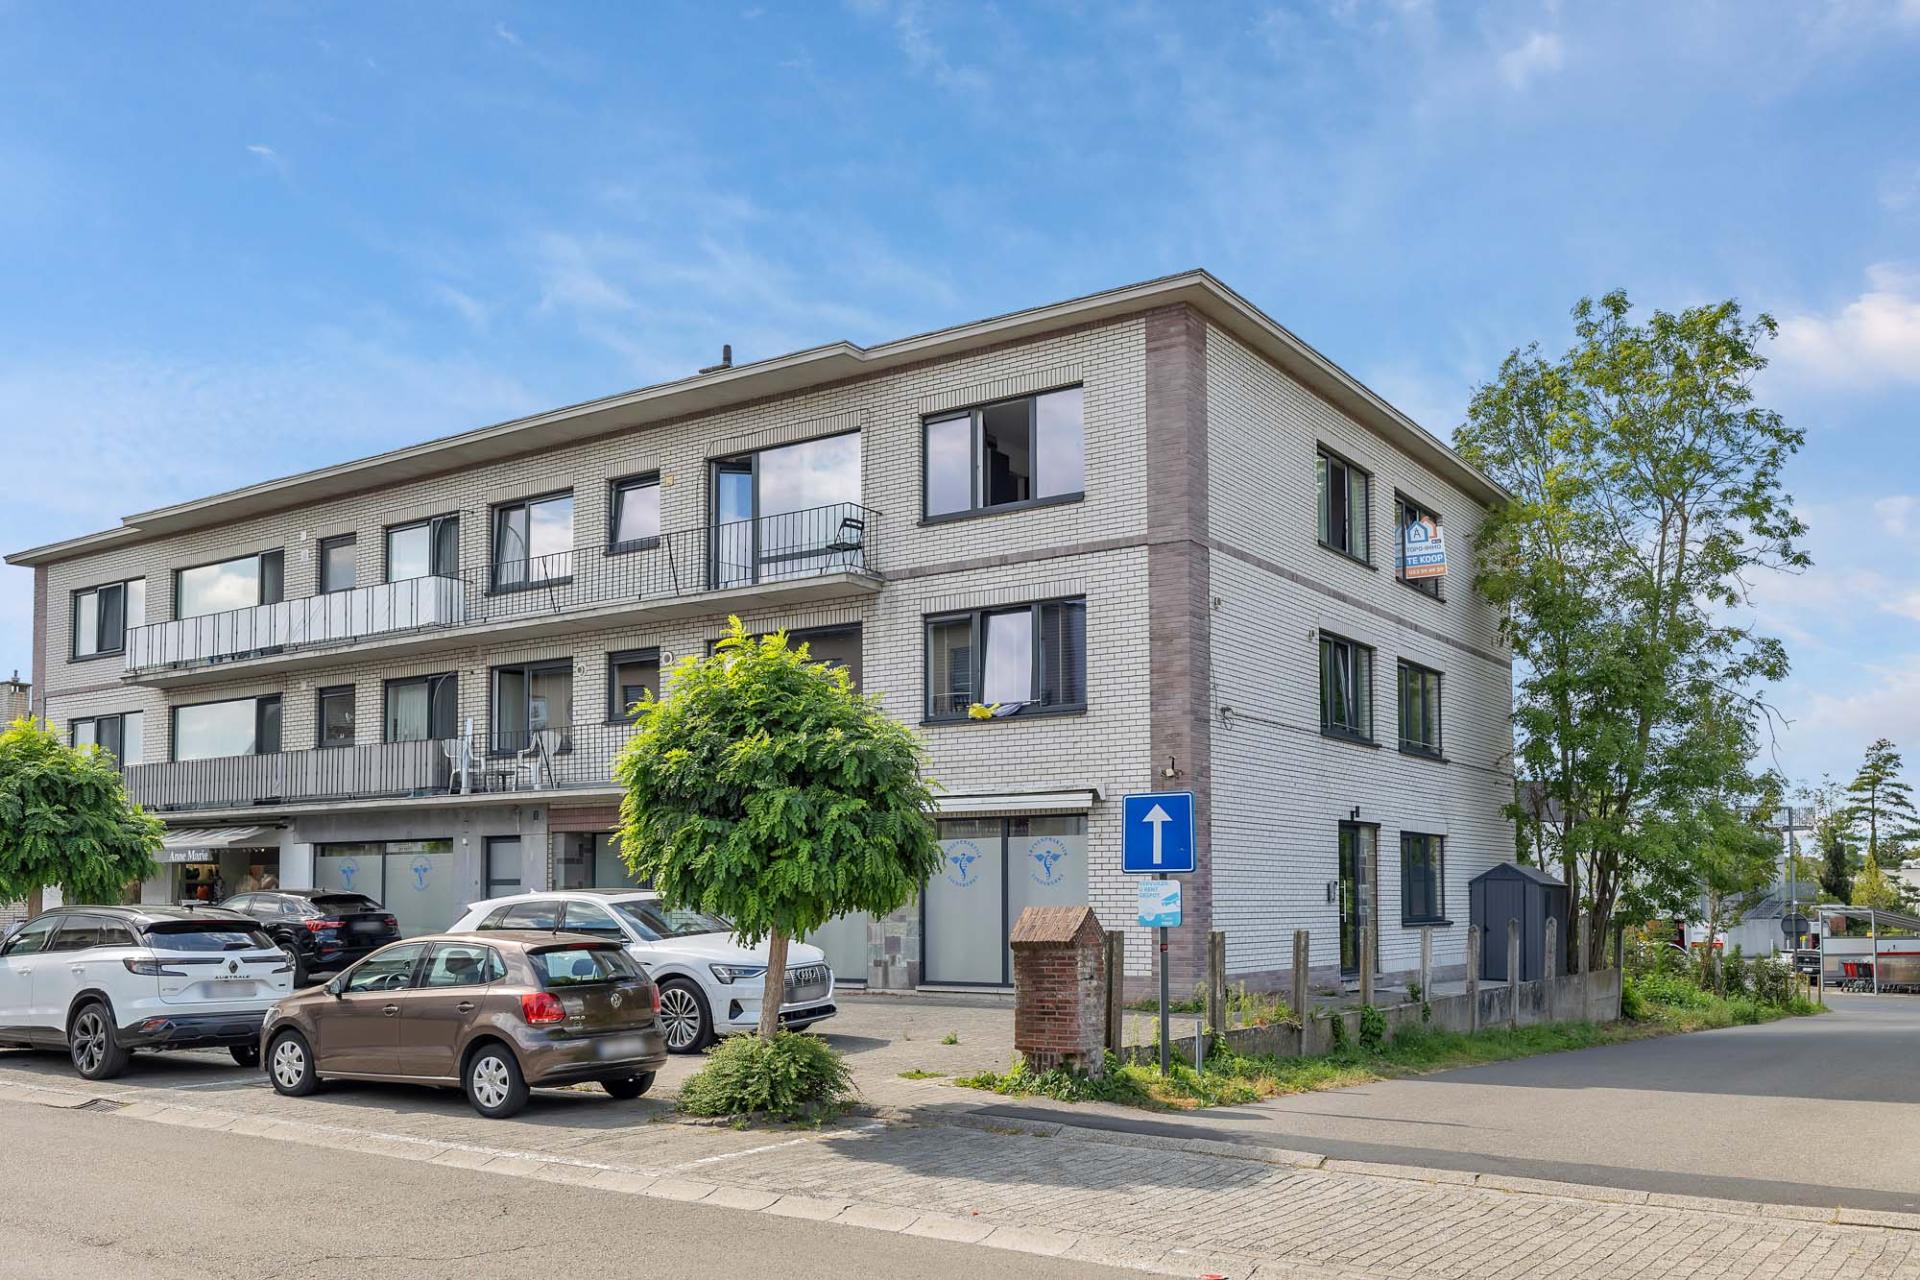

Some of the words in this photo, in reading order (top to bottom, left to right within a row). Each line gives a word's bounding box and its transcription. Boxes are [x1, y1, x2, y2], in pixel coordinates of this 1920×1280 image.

[1406, 556, 1419, 565] TE
[1420, 554, 1443, 564] KOOP
[169, 850, 187, 862] Anne
[188, 849, 209, 862] Marie
